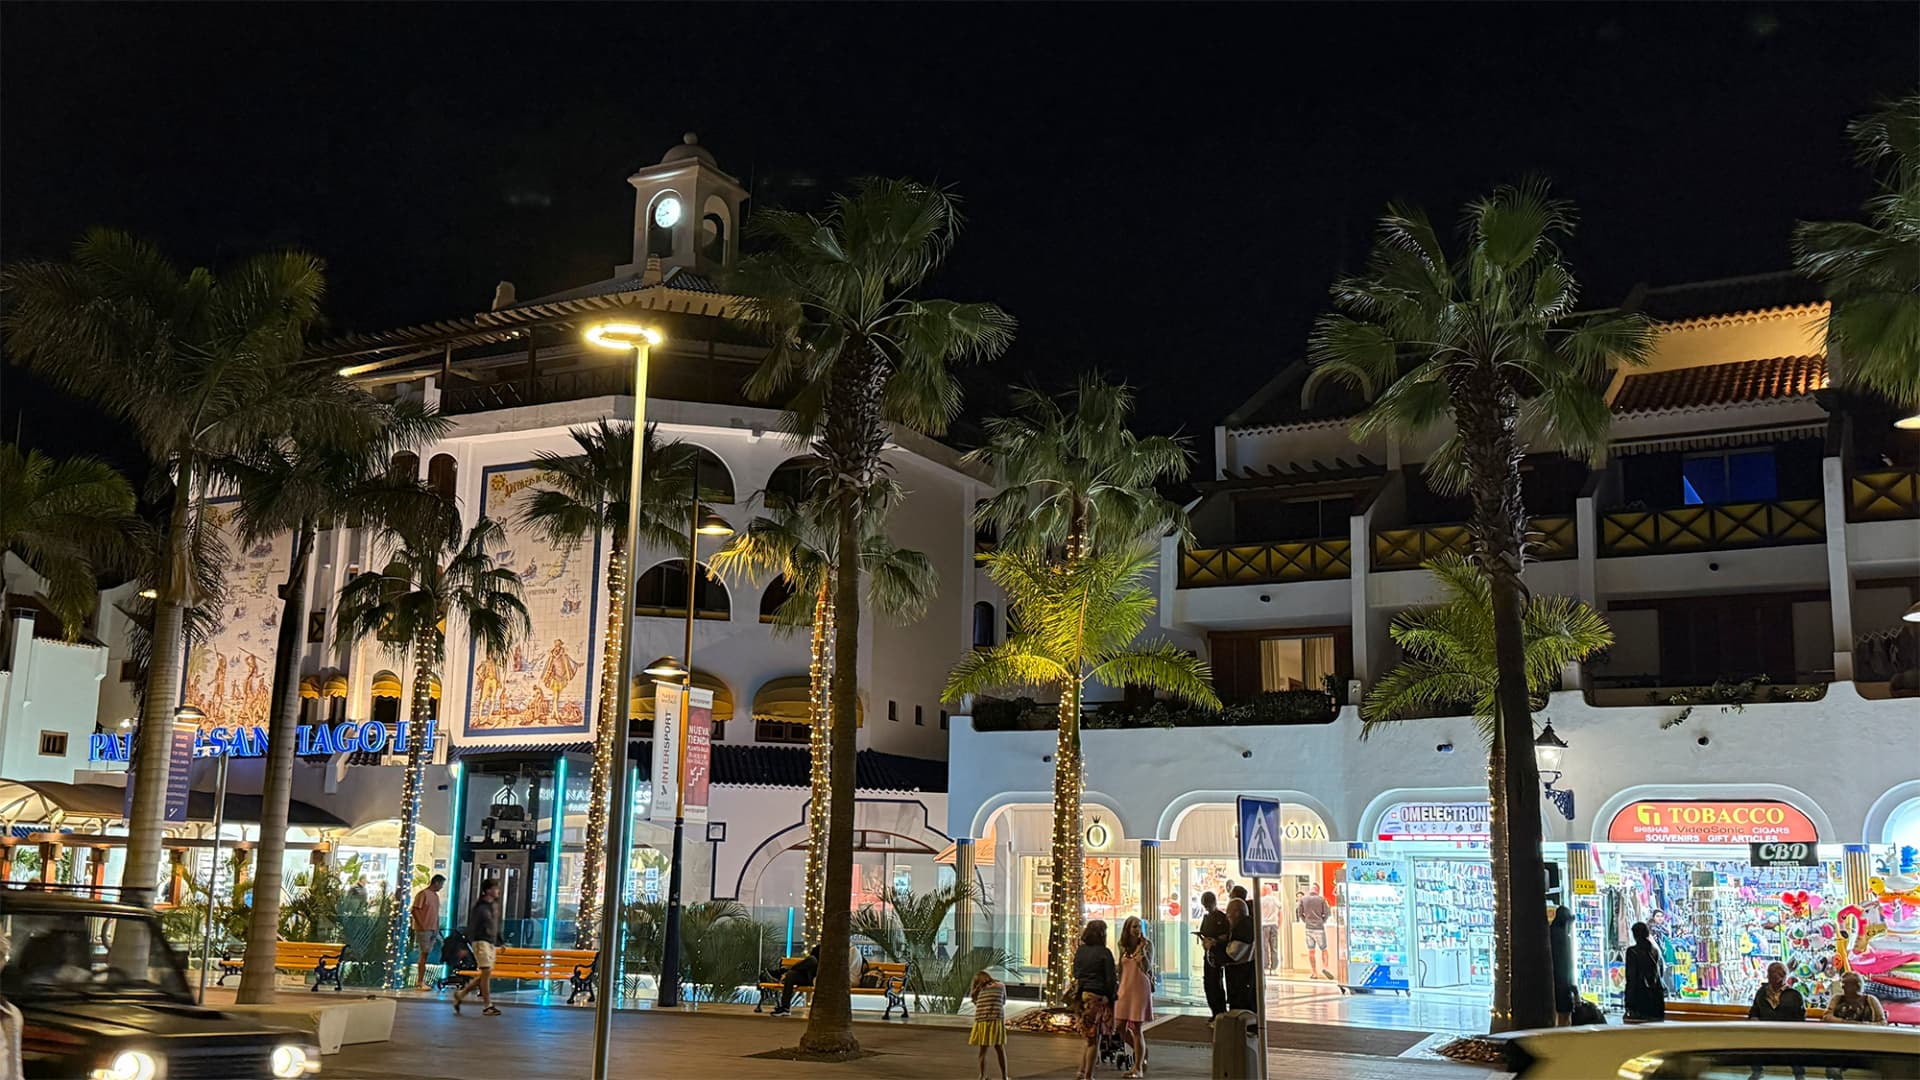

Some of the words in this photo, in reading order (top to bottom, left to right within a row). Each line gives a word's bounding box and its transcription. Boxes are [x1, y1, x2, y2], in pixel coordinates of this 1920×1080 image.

[209, 720, 387, 757] SANIAGO
[661, 711, 672, 784] INTERSPORT
[1668, 807, 1785, 825] TOBACCO
[1645, 834, 1700, 843] SOUVENIRS
[1707, 834, 1728, 843] GIFT
[1731, 834, 1779, 843] ARTICLES
[1676, 825, 1745, 834] VideoSonic
[1752, 826, 1790, 834] CIGARS
[1758, 842, 1808, 860] CBD
